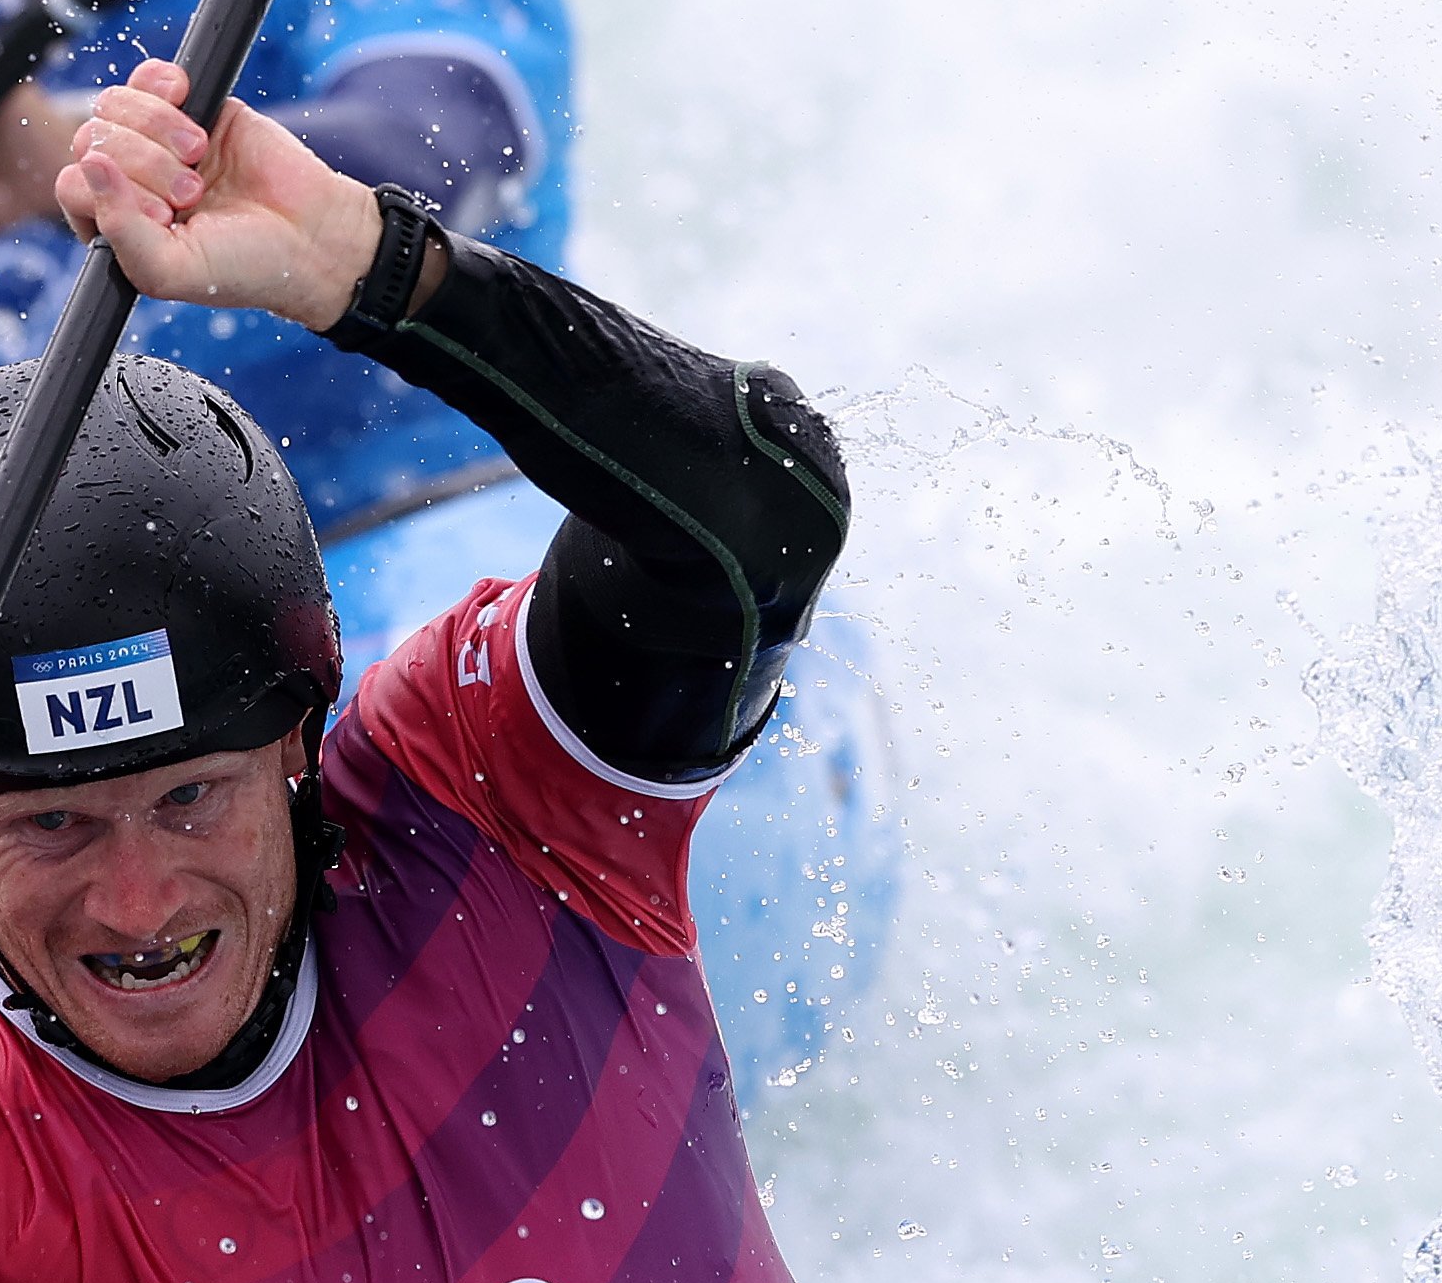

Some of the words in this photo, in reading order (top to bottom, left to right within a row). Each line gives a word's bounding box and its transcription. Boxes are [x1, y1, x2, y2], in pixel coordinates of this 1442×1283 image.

[57, 654, 104, 670] PARIS
[108, 643, 149, 661] 2024
[45, 679, 154, 738] NZL
